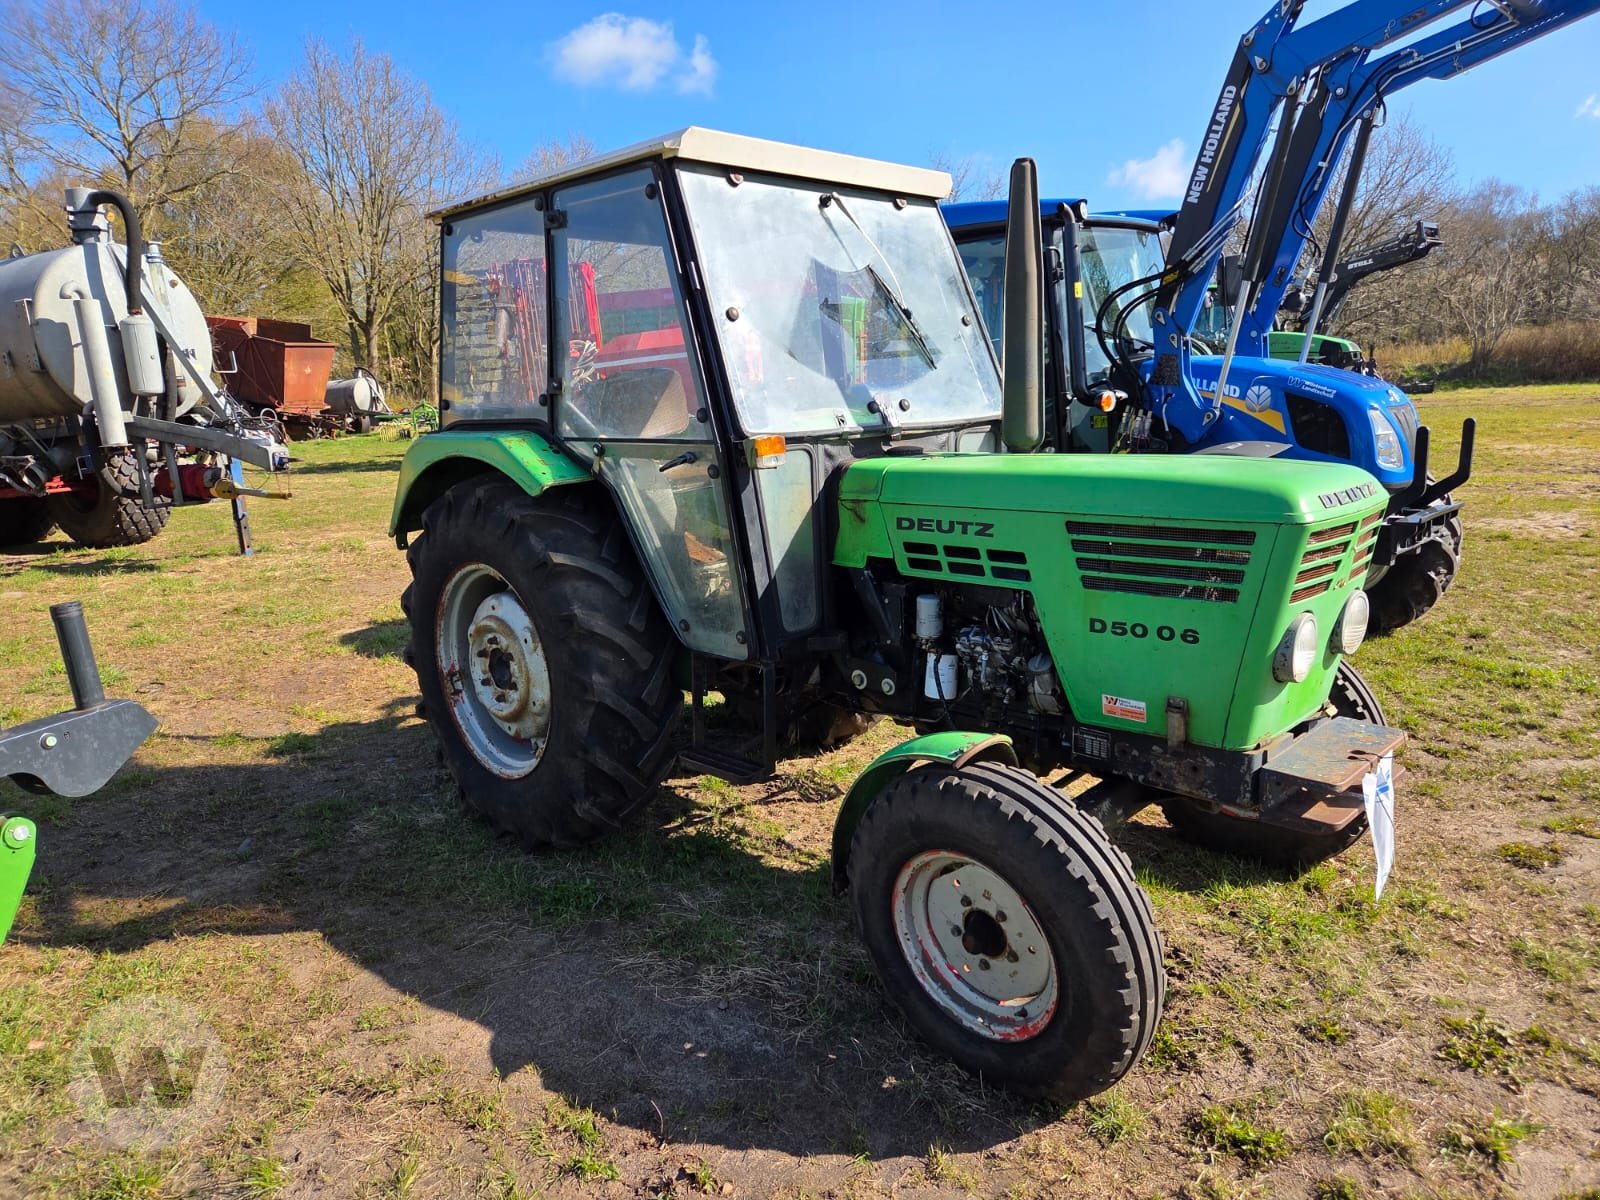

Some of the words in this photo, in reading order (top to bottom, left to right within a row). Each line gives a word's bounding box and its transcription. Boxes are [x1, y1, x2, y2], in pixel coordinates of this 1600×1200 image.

[1187, 165, 1209, 204] NEW
[1201, 85, 1237, 163] HOLLAND
[896, 517, 994, 538] DEUTZ
